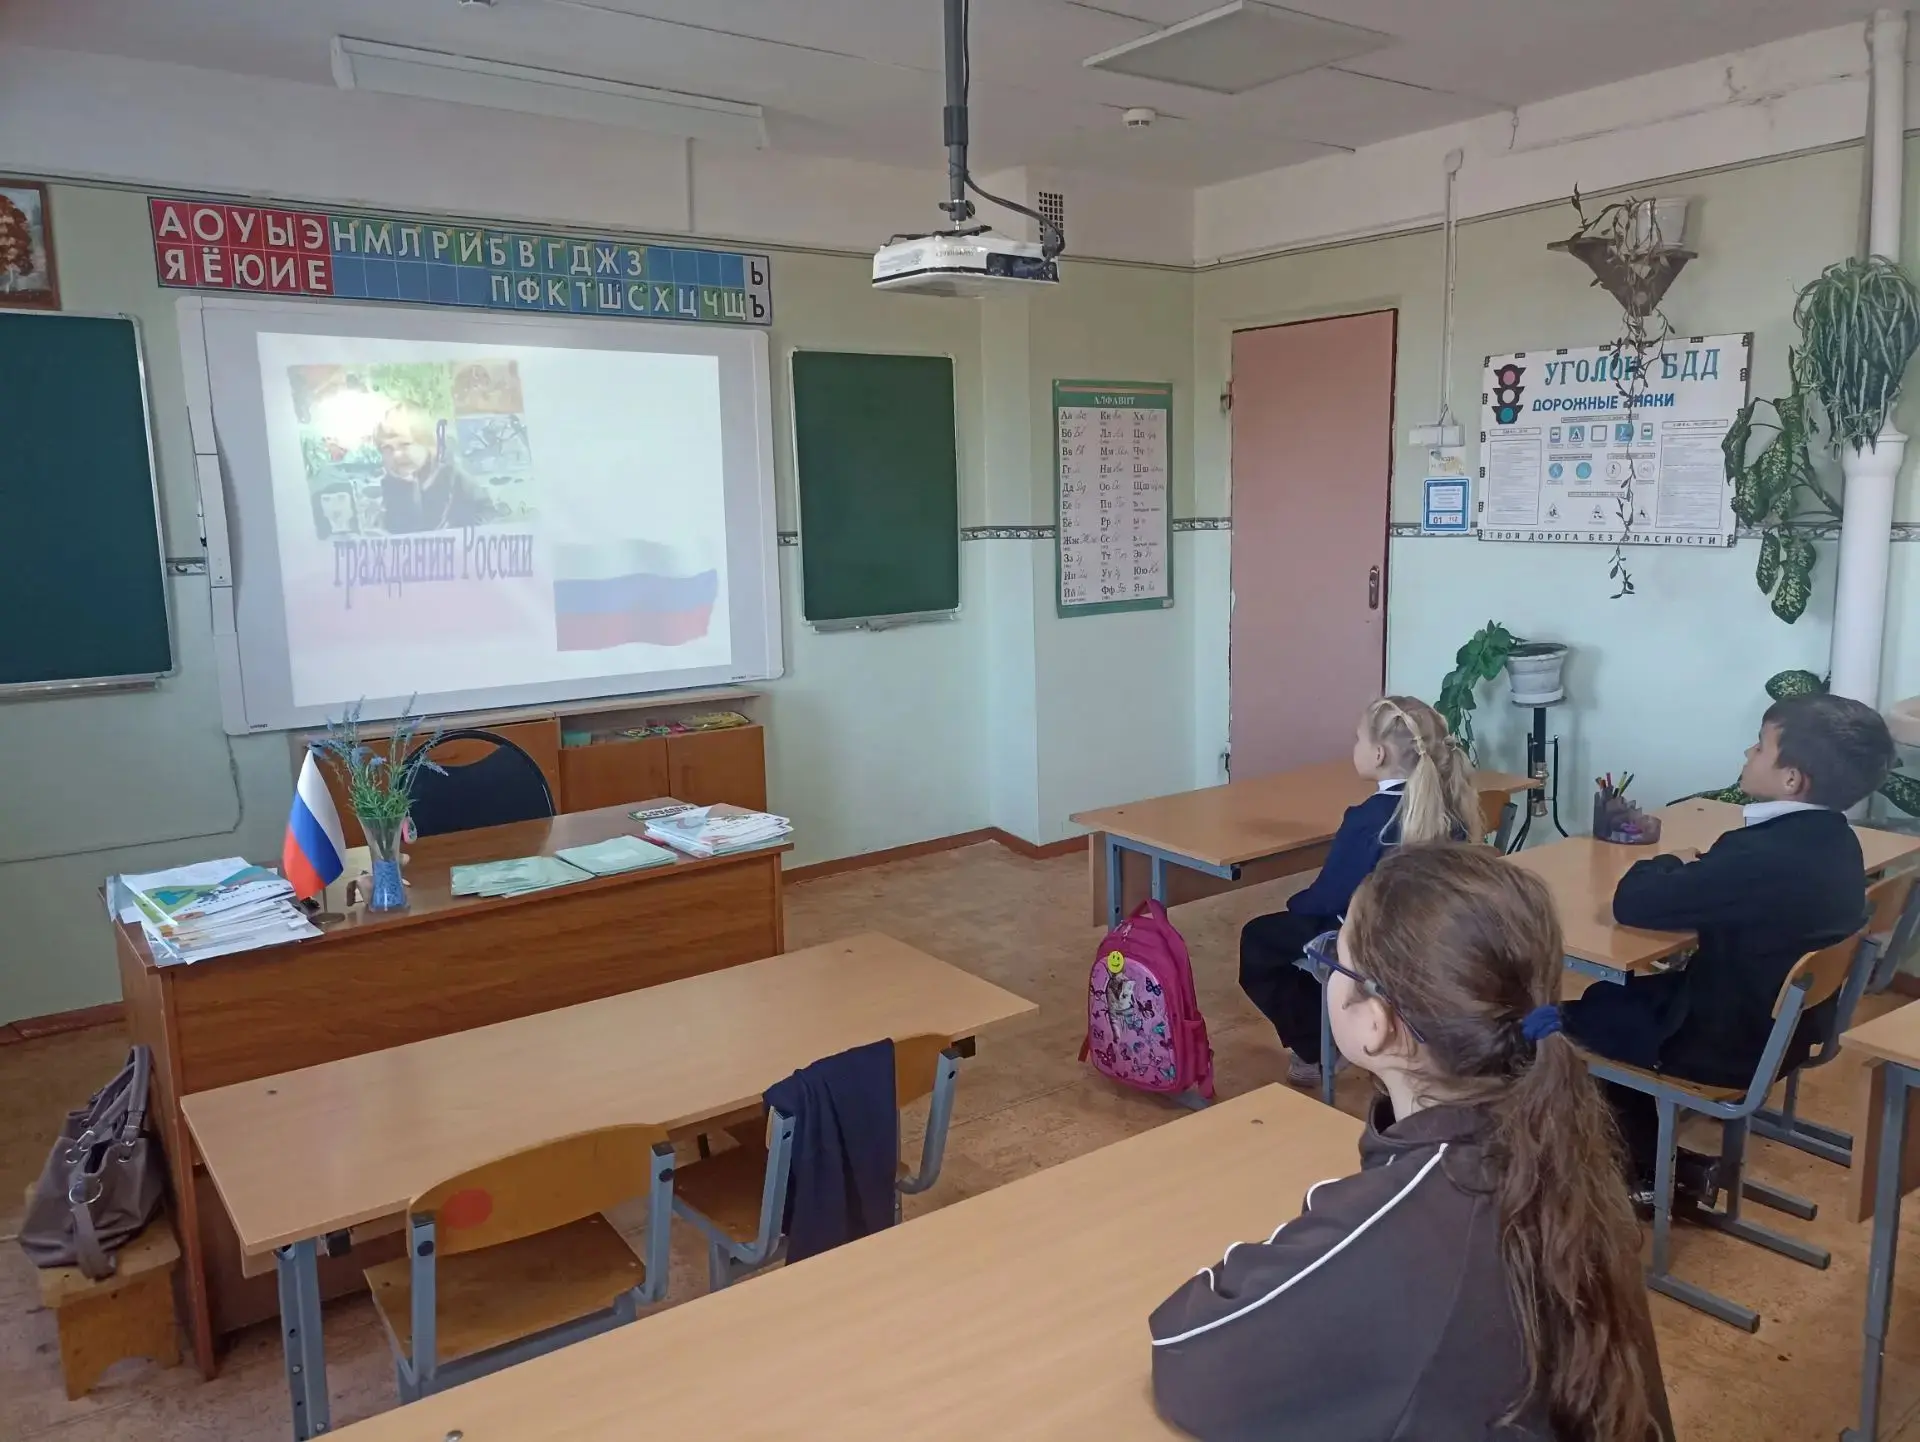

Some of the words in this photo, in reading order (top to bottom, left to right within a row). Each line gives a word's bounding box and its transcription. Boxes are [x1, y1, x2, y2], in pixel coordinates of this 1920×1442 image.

[159, 206, 187, 239] А
[193, 209, 224, 240] О
[232, 212, 255, 243] У
[267, 215, 295, 247] Ы
[302, 219, 323, 248] Э
[332, 221, 356, 252] Н
[365, 225, 392, 255] М
[398, 228, 420, 257] Л
[434, 232, 449, 259] Р
[460, 230, 482, 262] Й
[489, 238, 504, 266] Б
[519, 240, 534, 268] В
[547, 243, 560, 269] Г
[571, 246, 592, 276] Д
[596, 248, 620, 274] Ж
[627, 251, 642, 276] З
[751, 262, 763, 285] Ь
[165, 249, 186, 281] Я
[203, 248, 224, 283] Ё
[235, 254, 265, 286] Ю
[271, 257, 296, 287] И
[308, 260, 327, 290] Е
[491, 276, 510, 302] П
[518, 277, 540, 303] Ф
[548, 280, 566, 306] К
[576, 282, 592, 308] Т
[600, 284, 622, 309] Ш
[628, 286, 644, 311] С
[654, 287, 670, 312] Х
[680, 289, 696, 316] Ц
[704, 290, 718, 315] Ч
[724, 292, 746, 320] Щ
[750, 295, 764, 318] Ъ
[1661, 348, 1720, 382] БДД
[1094, 397, 1135, 405] АЛФАВИТ
[1532, 395, 1618, 412] ДОРОЖНЫЕ
[1622, 393, 1674, 408] НАКИ
[1489, 532, 1520, 540] ТВОЯ
[1528, 533, 1579, 542] ДОРОГА
[334, 536, 455, 609] гражданин
[461, 525, 533, 580] России
